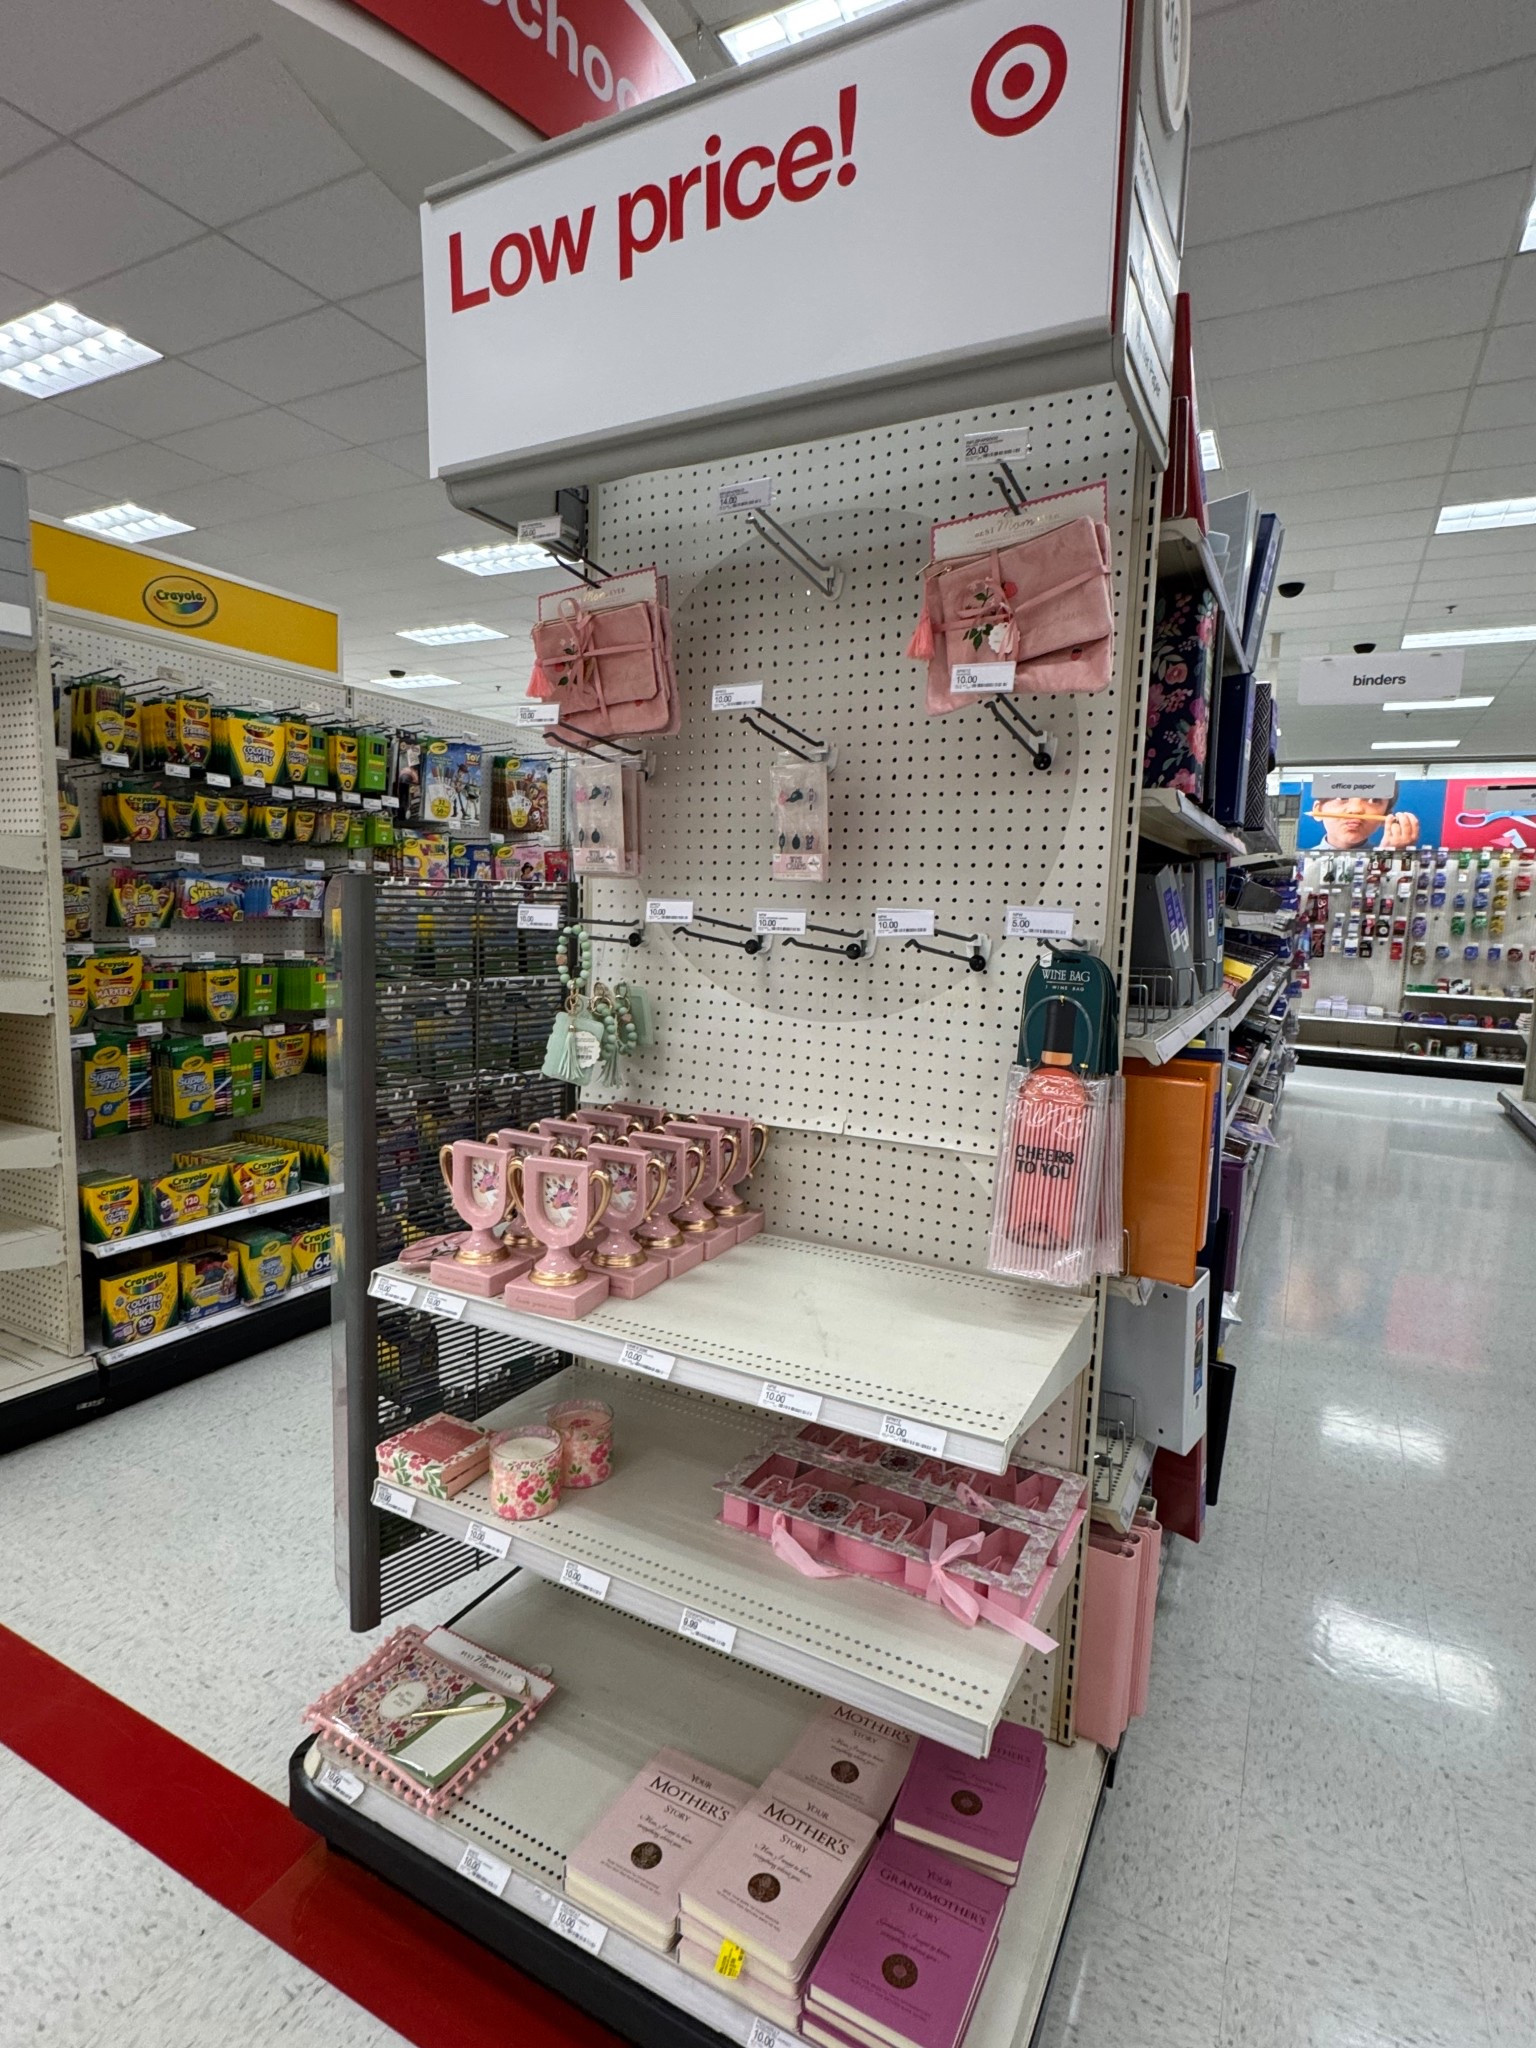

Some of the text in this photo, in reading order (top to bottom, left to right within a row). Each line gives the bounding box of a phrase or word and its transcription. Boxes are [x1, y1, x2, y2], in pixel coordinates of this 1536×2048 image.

[448, 84, 858, 314] Low price!
[966, 446, 989, 457] 20.00
[156, 590, 204, 603] Crayola
[956, 675, 978, 683] 10.00
[1352, 674, 1407, 686] binders
[715, 695, 732, 703] 10.00
[520, 712, 535, 720] 10.00
[245, 753, 273, 766] PENCILS
[466, 753, 480, 762] TOY
[649, 908, 666, 916] 10.00
[759, 919, 777, 927] 10.00
[878, 921, 899, 929] 10.00
[1012, 919, 1030, 928] 5.00
[98, 960, 130, 969] Crayola
[1042, 969, 1090, 983] WINE BAG
[95, 987, 133, 998] MARKERS
[89, 1071, 120, 1083] Super
[177, 1075, 206, 1087] Super
[1015, 1144, 1074, 1163] CHEERS
[252, 1159, 285, 1171] Crayola
[1015, 1160, 1071, 1180] TO YOU
[172, 1172, 208, 1186] Crayola
[265, 1180, 275, 1189] 96
[101, 1185, 130, 1196] Crayola
[185, 1196, 199, 1206] 120
[314, 1254, 331, 1269] 64
[124, 1271, 164, 1289] Crayola
[264, 1284, 277, 1292] 100
[377, 1283, 392, 1293] 10.00
[126, 1293, 163, 1311] COLORED
[129, 1302, 161, 1318] PENCILS
[190, 1306, 200, 1314] 50
[138, 1317, 154, 1327] 100
[624, 1350, 643, 1362] 10.00
[765, 1391, 786, 1404] 10.00
[885, 1423, 907, 1437] 10.00
[378, 1492, 392, 1503] 10.00
[754, 1474, 913, 1544] MOM
[469, 1530, 486, 1543] 10.00
[564, 1569, 582, 1582] 10.00
[682, 1617, 700, 1630] 9.99
[474, 1655, 497, 1675] Mom
[833, 1705, 913, 1745] MOTHER'S
[852, 1729, 877, 1745] STORY
[327, 1769, 344, 1786] 10.00
[691, 1773, 713, 1789] YOUR
[650, 1776, 730, 1822] MOTHER'S
[664, 1805, 691, 1822] STORY
[805, 1802, 829, 1820] YOUR
[763, 1802, 849, 1856] MOTHER'S
[779, 1833, 809, 1854] STORY
[464, 1856, 481, 1871] 10.00
[927, 1868, 952, 1888] YOUR
[880, 1867, 987, 1927] GRANDMOTHER'S
[908, 1902, 940, 1924] STORY
[557, 1912, 576, 1928] 10.00
[753, 2029, 775, 2048] 10.00
